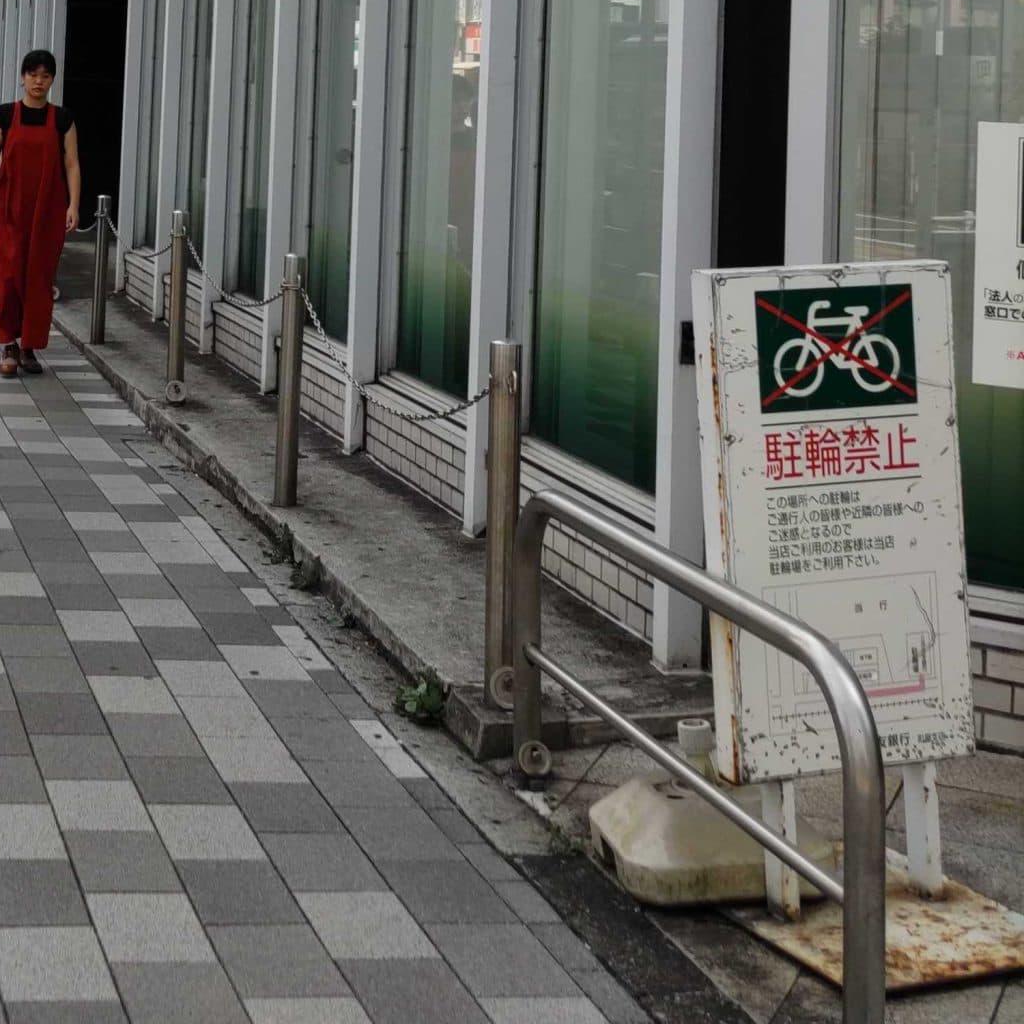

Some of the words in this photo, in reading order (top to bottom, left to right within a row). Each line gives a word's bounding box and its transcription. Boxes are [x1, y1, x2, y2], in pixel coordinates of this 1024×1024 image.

[984, 305, 1024, 320] 窓口で
[765, 423, 920, 481] 駐輪禁止
[766, 490, 860, 510] この場所への駐輪は
[768, 535, 895, 560] 当店ご利用のお客様は当店
